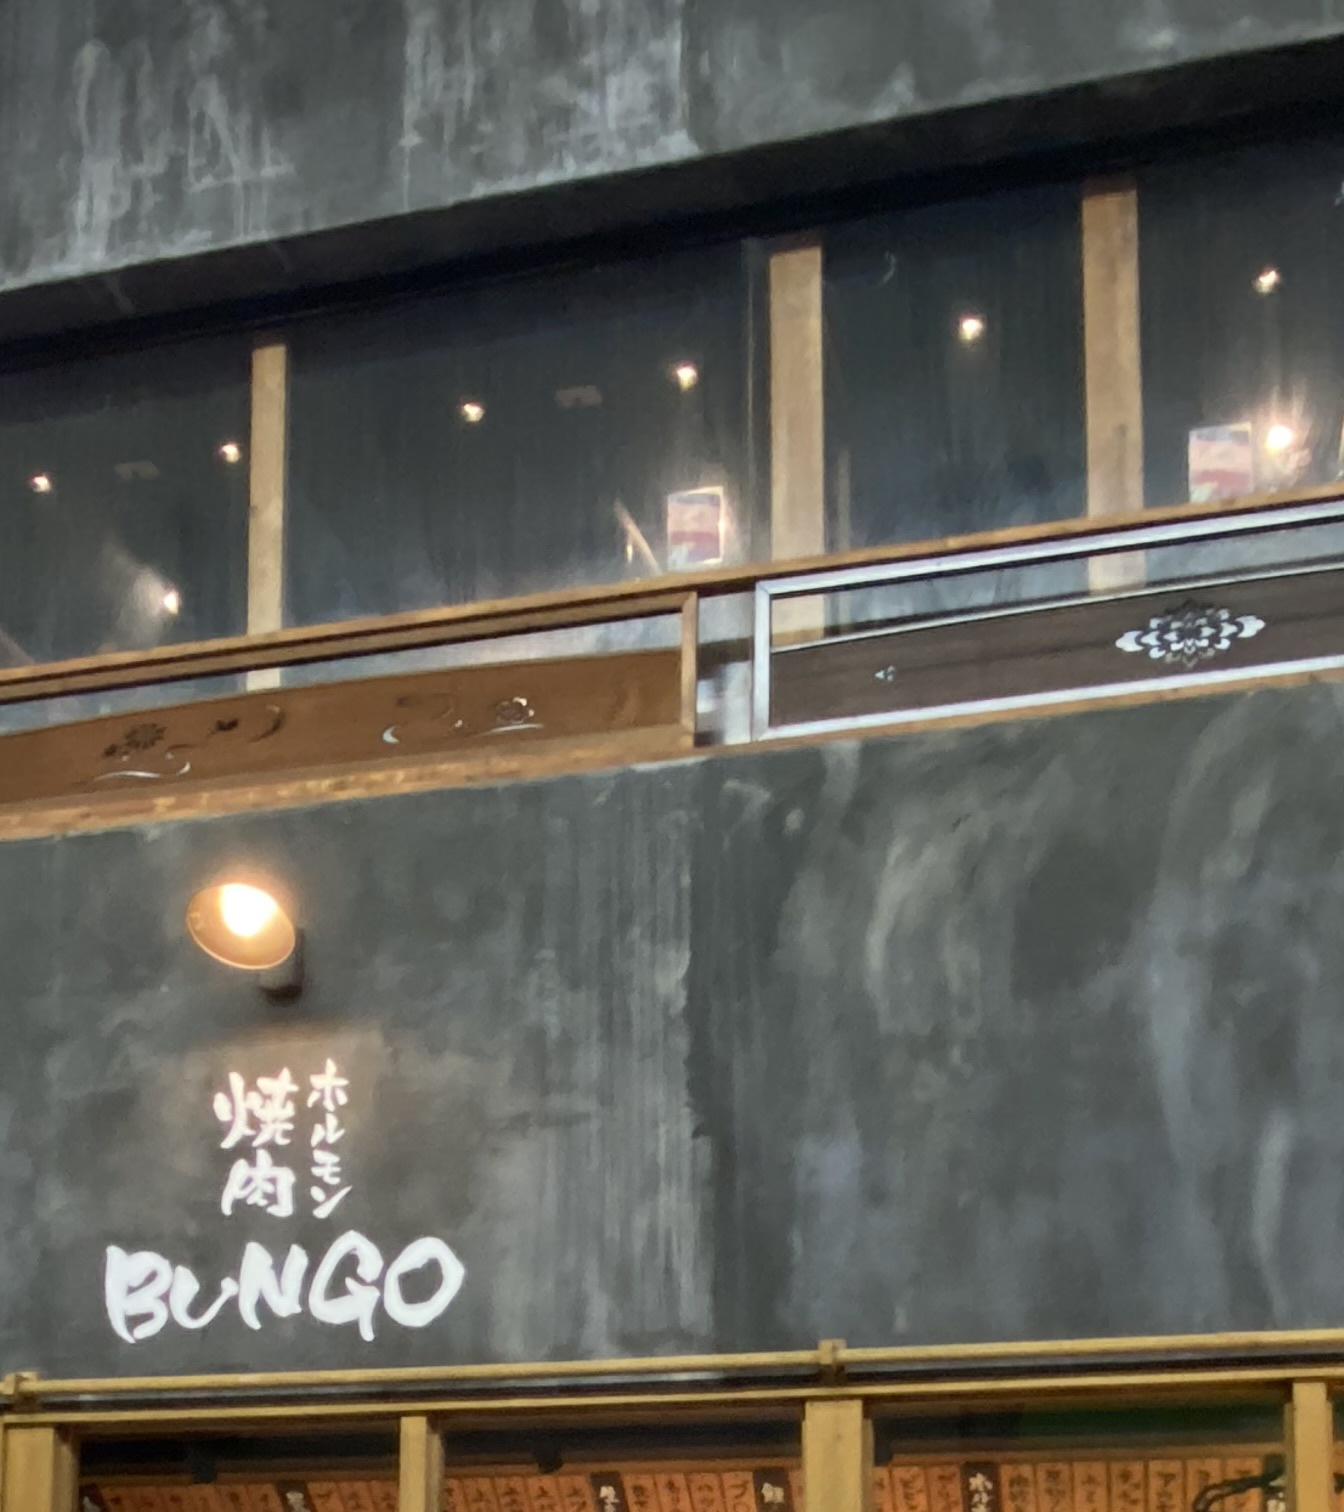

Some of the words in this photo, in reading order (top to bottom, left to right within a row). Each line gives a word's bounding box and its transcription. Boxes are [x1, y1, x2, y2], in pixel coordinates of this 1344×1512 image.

[213, 1067, 299, 1217] 焼肉
[307, 1058, 352, 1218] ホルモン
